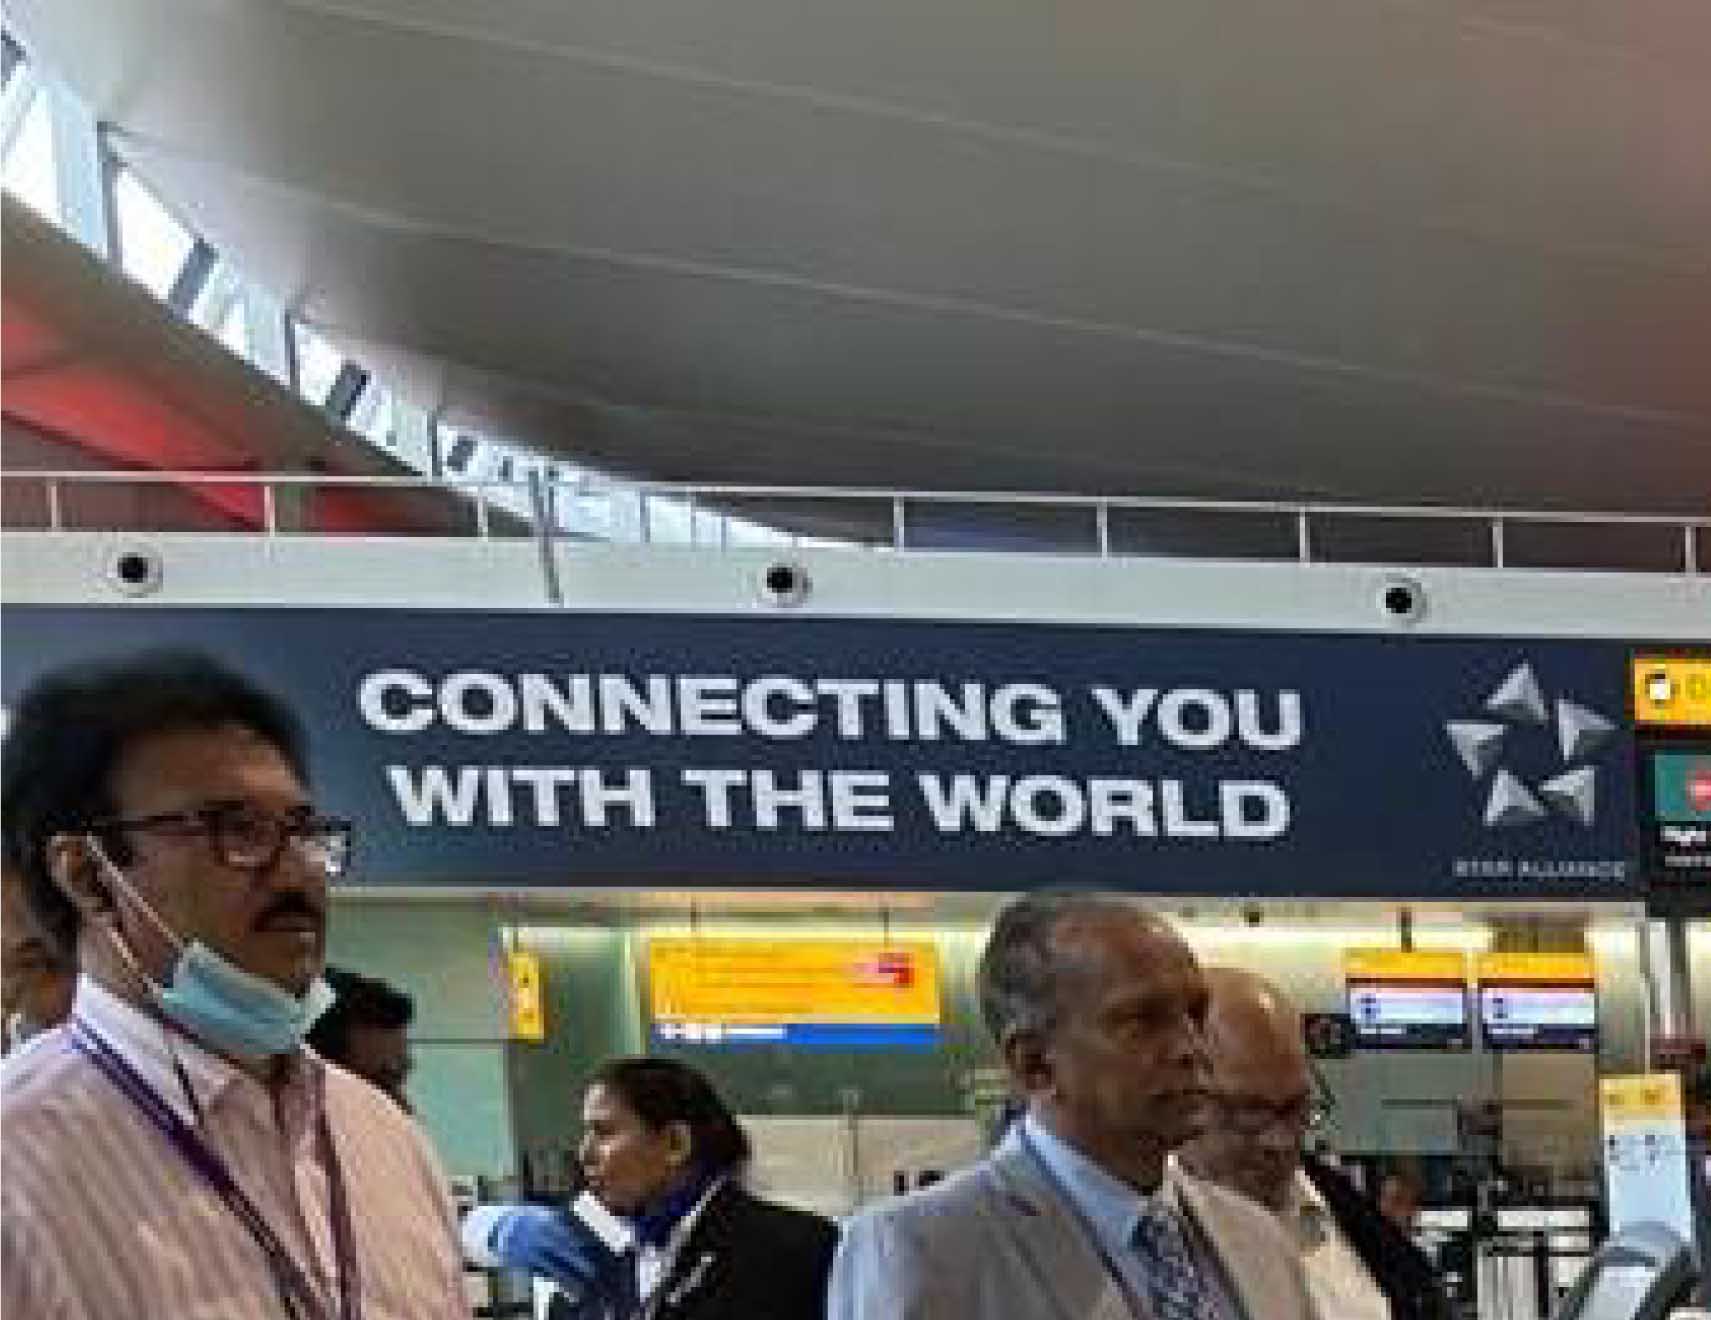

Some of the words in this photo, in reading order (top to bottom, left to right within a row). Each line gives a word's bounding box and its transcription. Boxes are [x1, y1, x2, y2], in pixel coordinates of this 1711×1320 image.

[360, 669, 1067, 746] CONNECTING
[1089, 688, 1302, 751] YOU
[384, 764, 657, 828] WITH
[679, 768, 895, 832] THE
[918, 774, 1292, 838] WORLD
